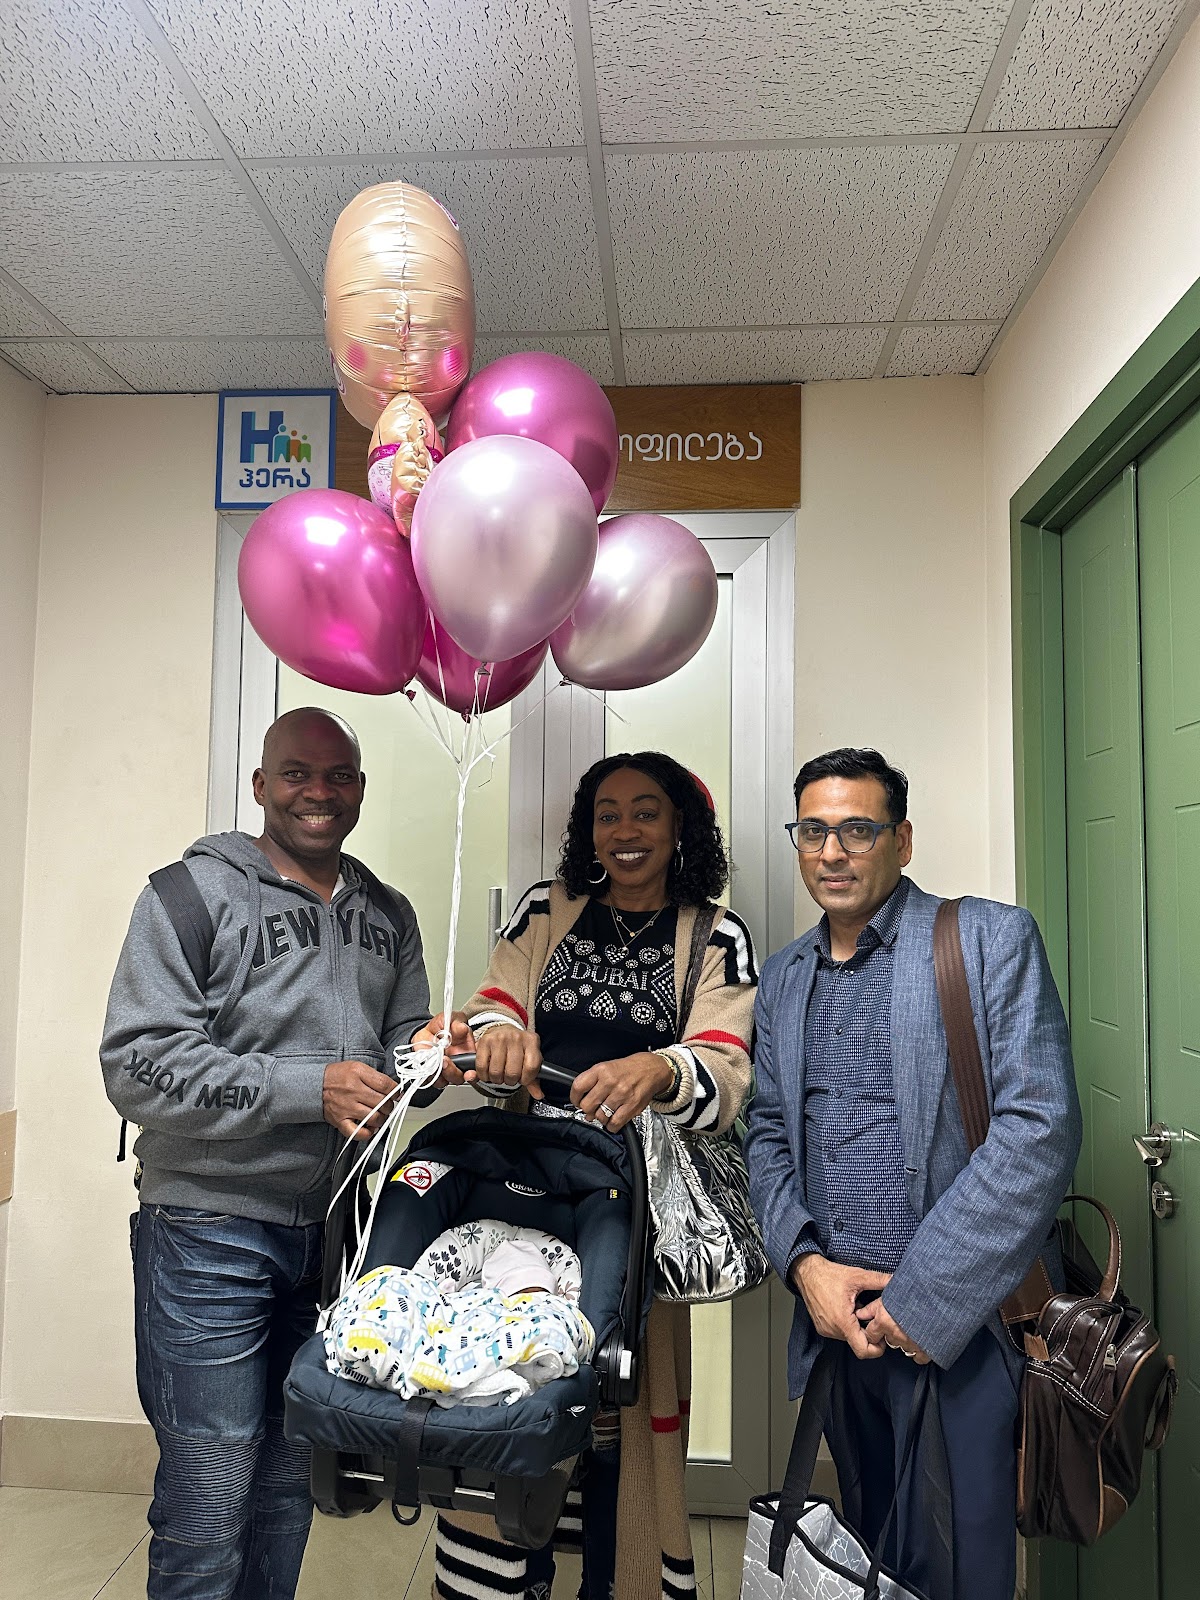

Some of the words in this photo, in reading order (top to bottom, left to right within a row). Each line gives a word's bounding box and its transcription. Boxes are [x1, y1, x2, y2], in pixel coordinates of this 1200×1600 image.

[618, 432, 763, 462] ოფილება
[239, 467, 311, 488] ჰერა
[570, 960, 649, 991] DUBAI
[122, 1048, 187, 1103] YORK
[193, 1083, 260, 1110] NEW
